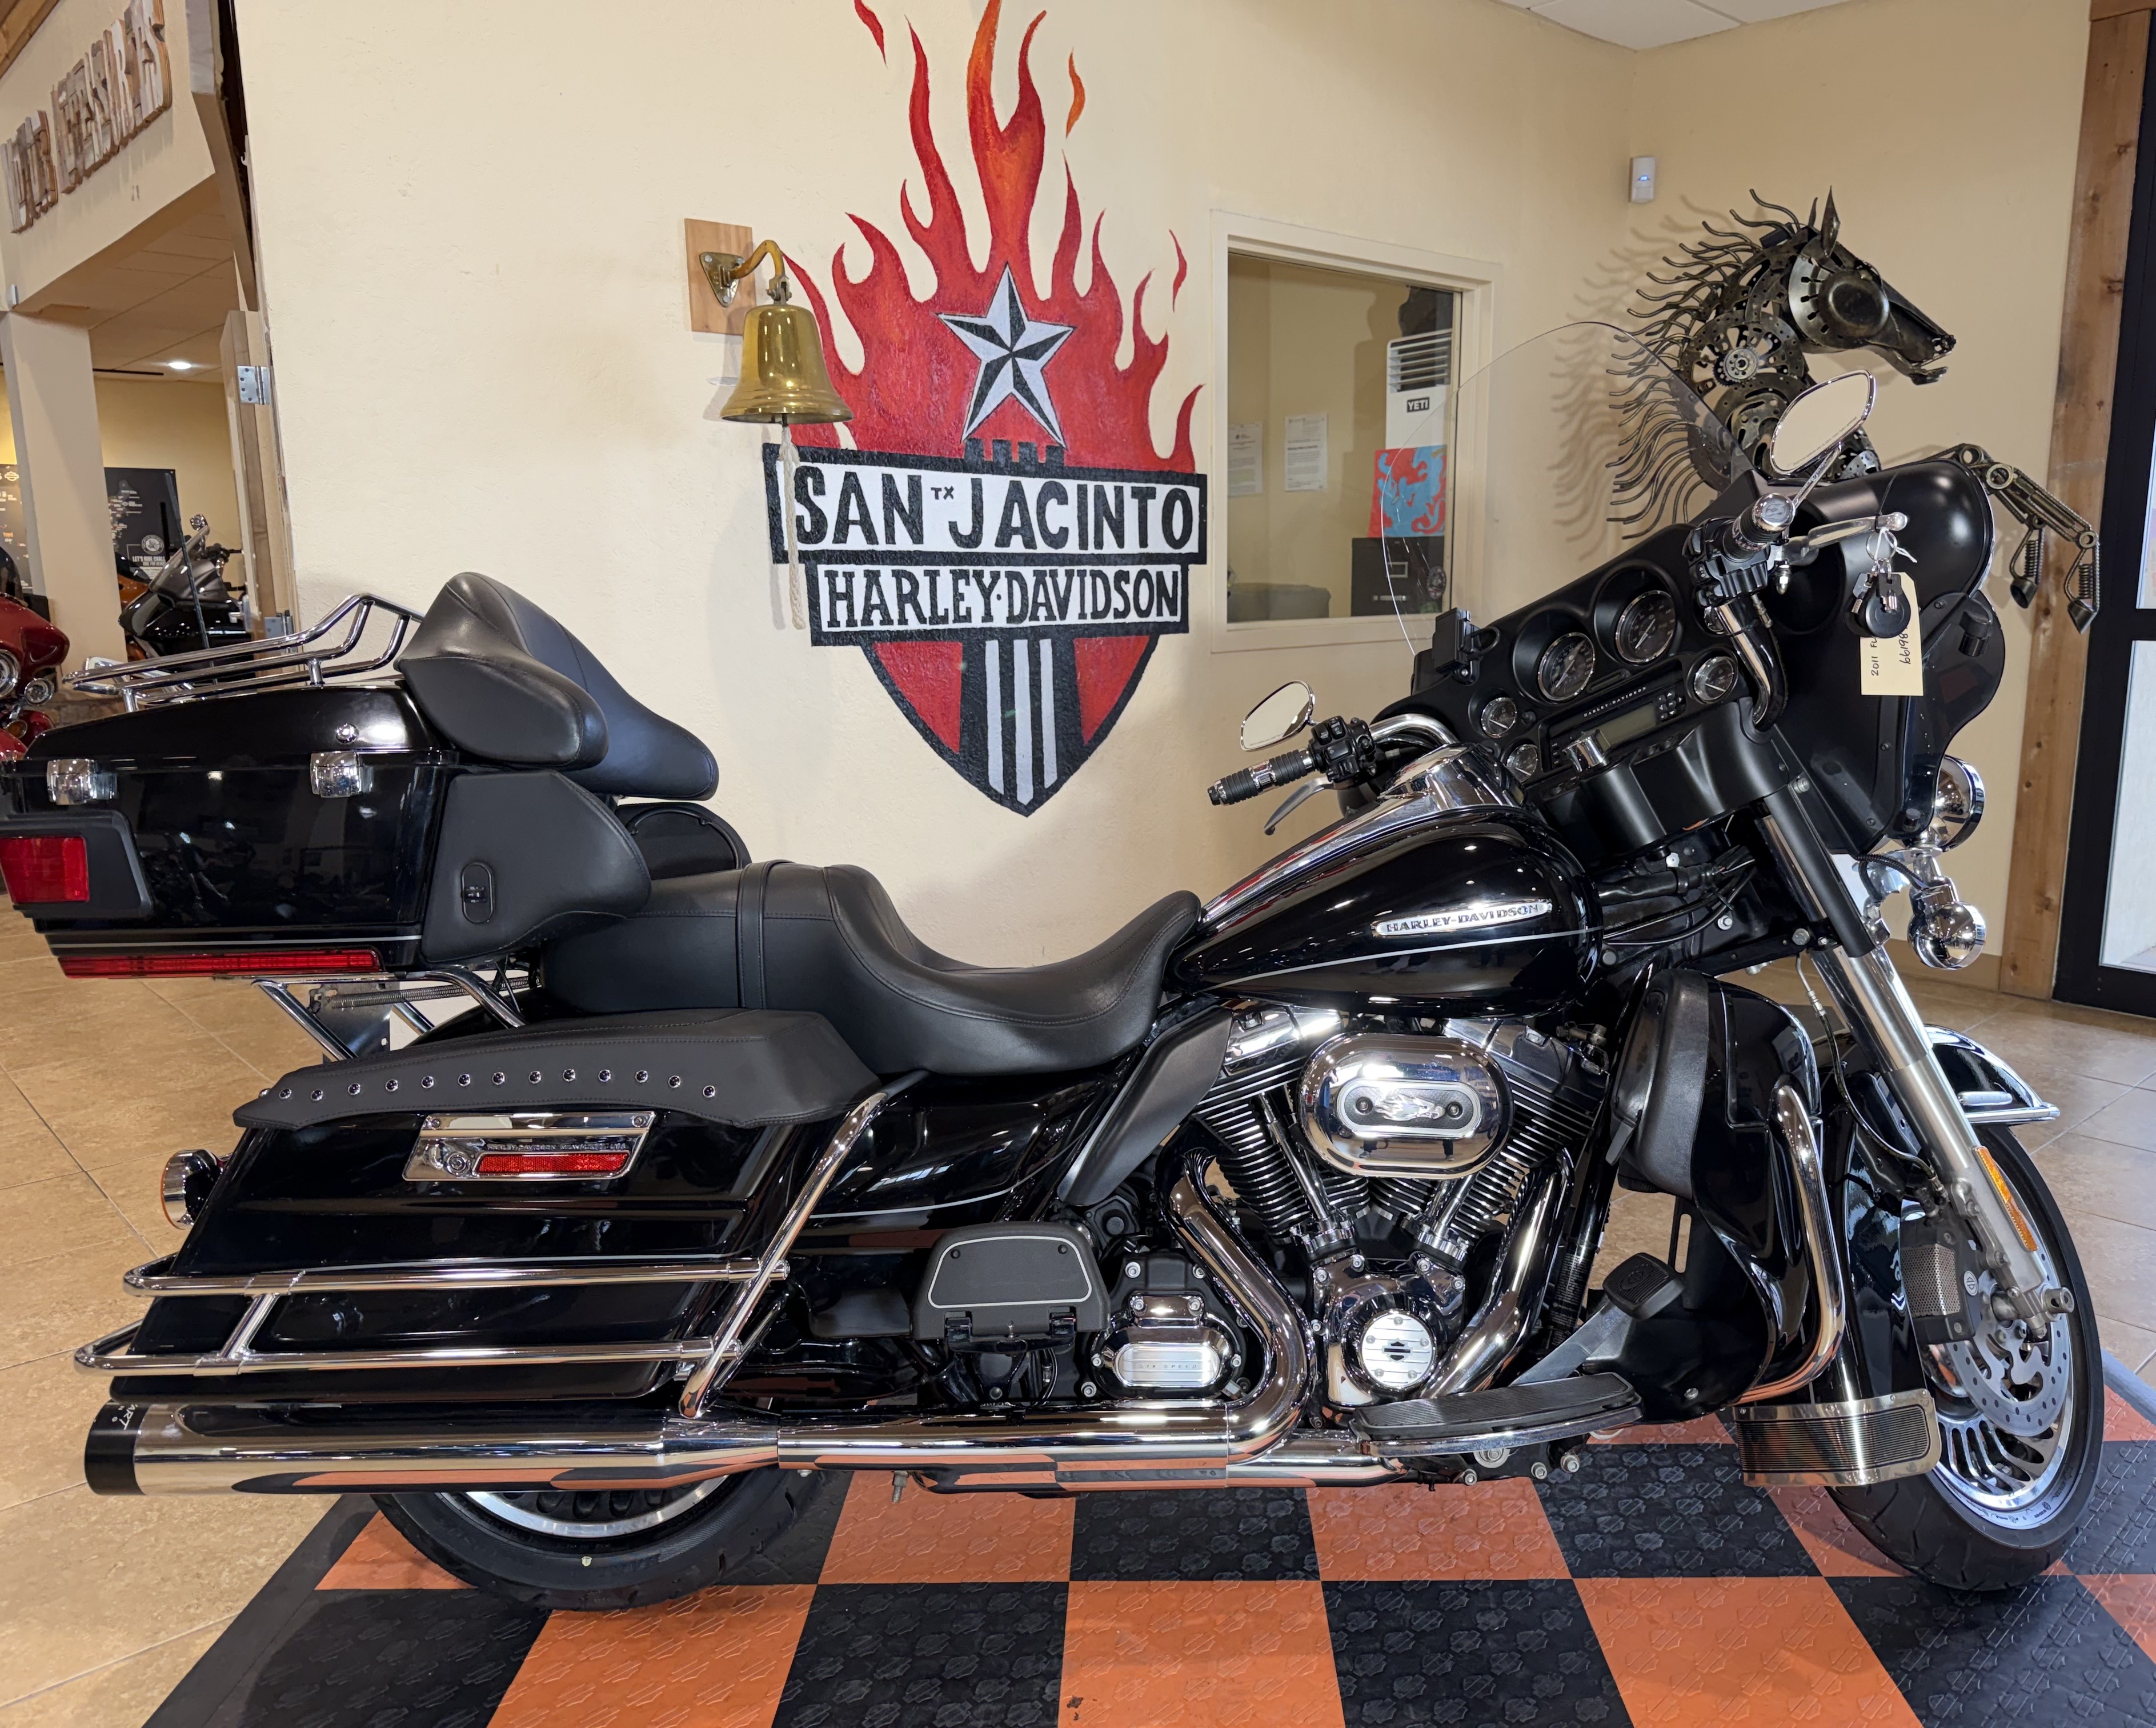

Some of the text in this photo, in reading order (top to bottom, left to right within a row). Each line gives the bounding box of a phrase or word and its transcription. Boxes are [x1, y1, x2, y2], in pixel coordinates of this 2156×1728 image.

[1408, 399, 1429, 411] YETI
[794, 465, 1193, 550] SAN TX JACINTO
[1898, 627, 1911, 664] 66198
[1871, 656, 1880, 676] 2011
[1584, 686, 1646, 717] HARLEY-DAVIDSON
[1386, 904, 1538, 933] HARLEY-DAVIDSON
